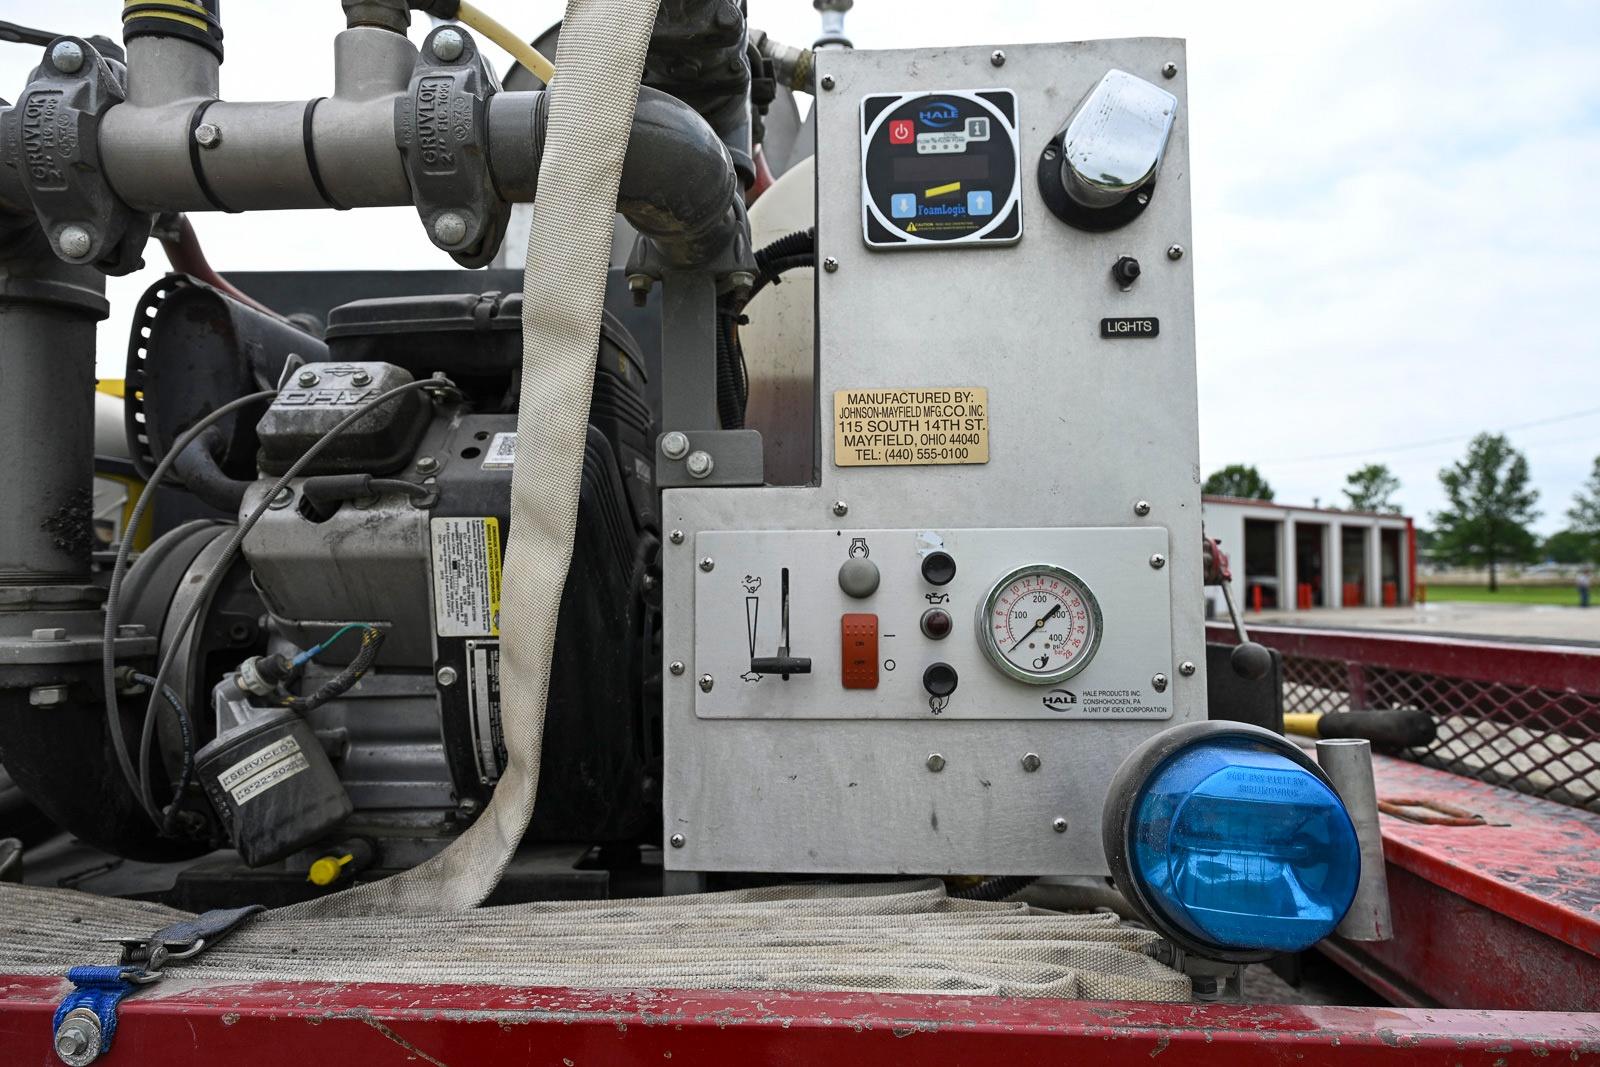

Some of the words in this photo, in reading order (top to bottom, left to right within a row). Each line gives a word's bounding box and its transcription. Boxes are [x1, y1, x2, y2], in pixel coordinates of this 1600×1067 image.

[920, 110, 959, 119] HALE
[418, 84, 437, 162] GRUVLOK
[24, 100, 46, 178] GRUVLOK
[1108, 320, 1152, 332] LIGHTS
[848, 392, 950, 404] MANUFACTURED
[955, 392, 973, 403] BY:
[840, 406, 921, 418] JOHNSON-MAYFIELD
[969, 405, 984, 417] INC.
[840, 421, 862, 432] 115
[868, 420, 919, 432] SOUTH
[925, 420, 959, 431] 14TH
[965, 419, 986, 430] ST.
[844, 434, 917, 447] MAYFIELD,
[920, 434, 946, 445] OHIO
[950, 433, 979, 445] 44040
[856, 449, 881, 460] TEL:
[885, 449, 913, 462] (440)
[917, 448, 968, 459] 555-0100
